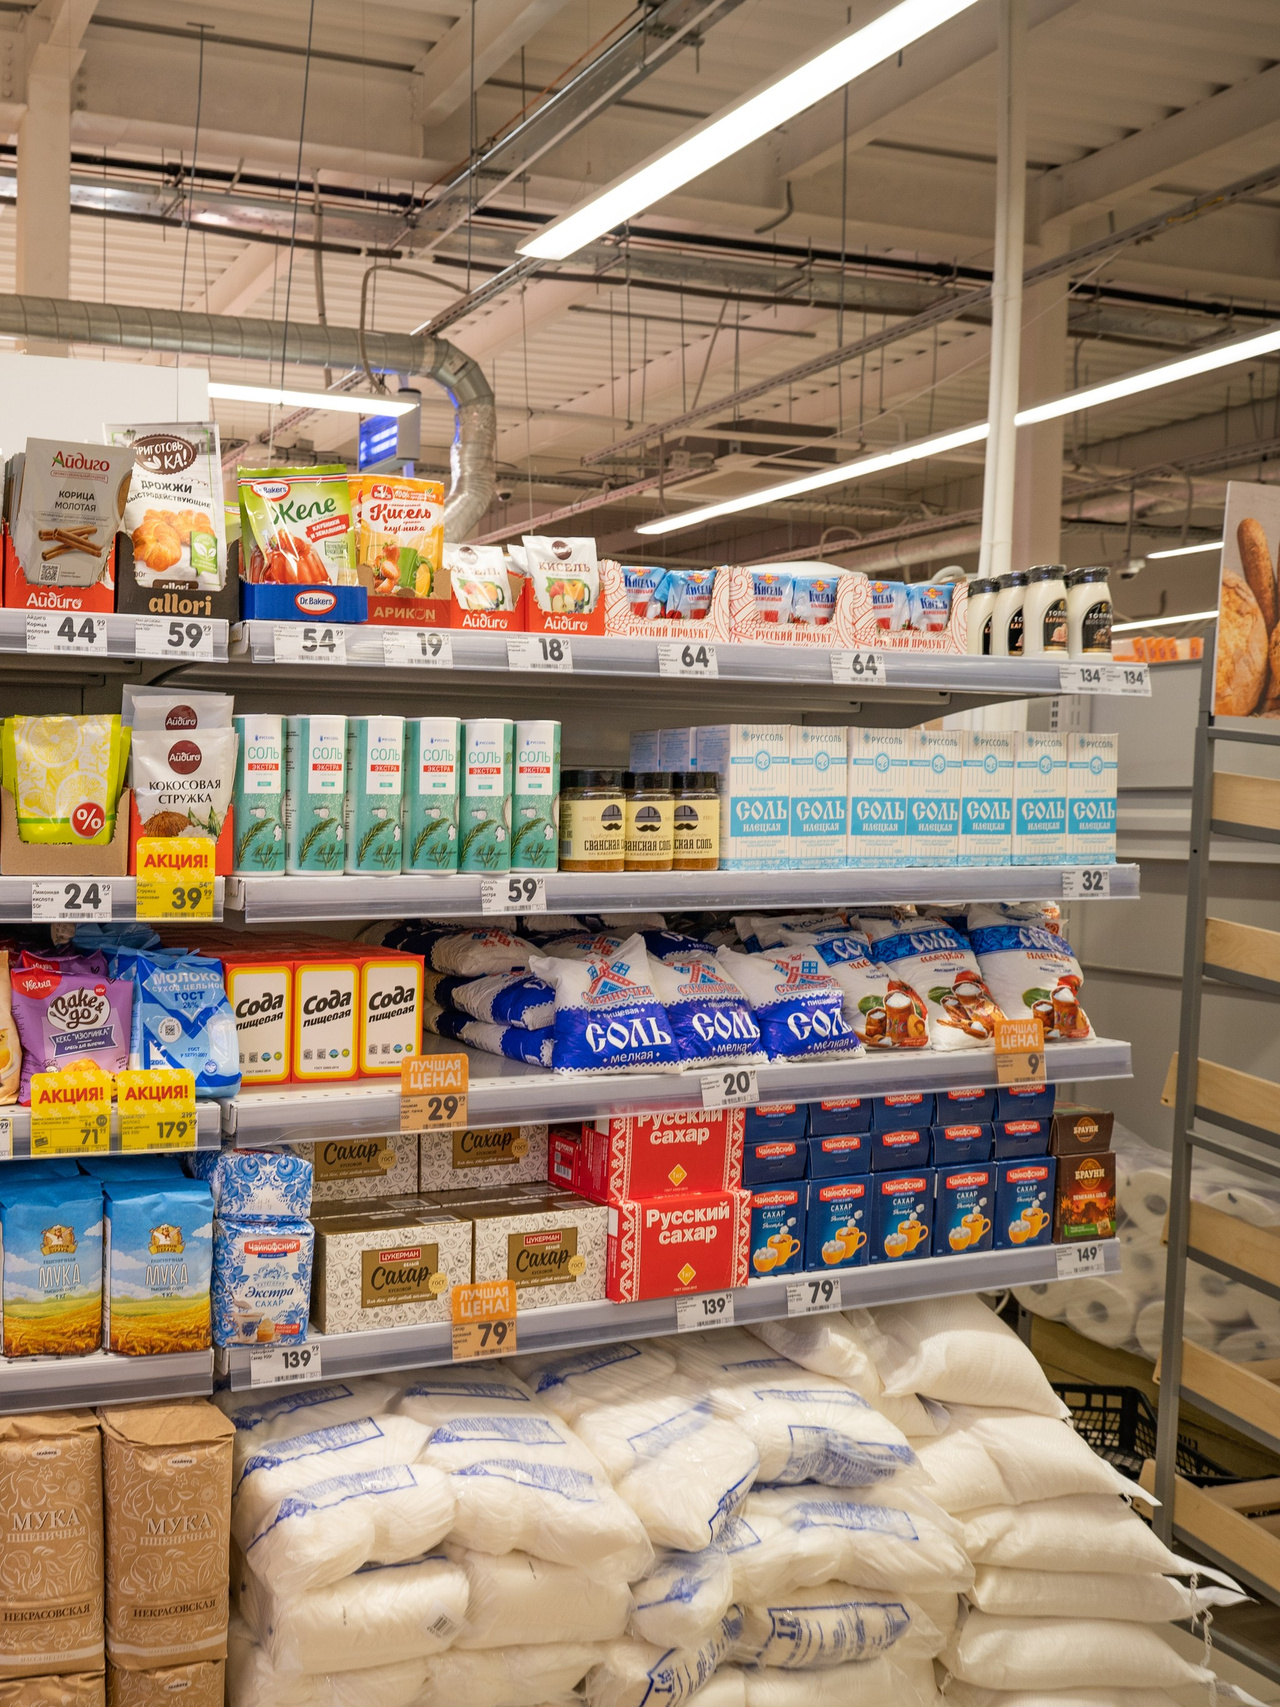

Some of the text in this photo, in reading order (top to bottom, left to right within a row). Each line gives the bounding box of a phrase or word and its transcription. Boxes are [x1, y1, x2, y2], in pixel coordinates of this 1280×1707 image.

[52, 451, 110, 471] Айдиго
[141, 480, 192, 494] ДРОЖЖИ
[59, 491, 95, 501] КОРИЦА
[55, 501, 96, 512] МОЛОТАЯ
[274, 498, 337, 524] Желе
[370, 502, 431, 521] Кисель
[539, 562, 591, 572] КИСЕЛЬ
[26, 592, 83, 609] Айдиго
[149, 593, 212, 615] allori
[57, 617, 97, 643] 44
[544, 616, 588, 631] Айдиго
[168, 622, 203, 648] 59
[302, 628, 335, 652] 54
[629, 626, 709, 639] РУССКИЙ ПРОДУКТ
[417, 632, 442, 656] 19
[538, 638, 563, 661] 18
[681, 645, 709, 668] 64
[1080, 668, 1100, 682] 134
[750, 733, 783, 742] РУССОЛЬ
[169, 753, 201, 762] Айдиго
[248, 747, 280, 760] СОЛЬ
[149, 779, 221, 791] КОКОСОВАЯ
[158, 794, 212, 804] СТРУЖКА
[736, 801, 787, 821] СОЛЬ
[743, 823, 781, 833] ИЛЕЦКАЯ
[144, 854, 208, 871] АКЦИЯ!
[1082, 871, 1102, 890] 32
[64, 884, 102, 909] 24
[172, 888, 202, 909] 39
[508, 879, 537, 902] 59
[153, 972, 220, 983] МОЛОКО
[175, 991, 204, 1001] ГОСТ
[303, 990, 352, 1015] Сода
[303, 1009, 351, 1028] пищевая
[586, 1017, 671, 1052] СОЛЬ
[1000, 1025, 1038, 1034] ЛУЧШАЯ
[1002, 1034, 1038, 1048] ЦЕНА!
[610, 1051, 654, 1064] мелкая
[1028, 1054, 1040, 1074] 9
[409, 1060, 461, 1073] ЛУЧШАЯ
[410, 1071, 461, 1089] ЦЕНА!
[723, 1071, 750, 1096] 20
[39, 1087, 104, 1105] АКЦИЯ!
[125, 1086, 188, 1103] АКЦИЯ!
[428, 1096, 458, 1121] 29
[81, 1128, 99, 1144] 71
[157, 1121, 188, 1139] 179
[1075, 1168, 1105, 1180] БРАУНИ
[892, 1197, 914, 1206] САХАР
[646, 1201, 730, 1230] Русский
[658, 1224, 717, 1245] сахар
[382, 1251, 419, 1260] ЦУКЕРМАН
[1077, 1246, 1098, 1262] 149
[371, 1266, 432, 1294] Сахар
[245, 1286, 294, 1300] Экстра
[459, 1287, 508, 1302] ЛУЧШАЯ
[808, 1280, 834, 1303] 79
[255, 1299, 284, 1308] САХАР
[461, 1299, 509, 1318] ЦЕНА!
[702, 1298, 725, 1315] 139
[478, 1322, 508, 1347] 79
[282, 1350, 311, 1369] 139
[11, 1509, 80, 1531] МУКА
[7, 1527, 86, 1542] ПШЕНИЧНАЯ
[4, 1605, 90, 1621] НЕКРАСОВСКАЯ
